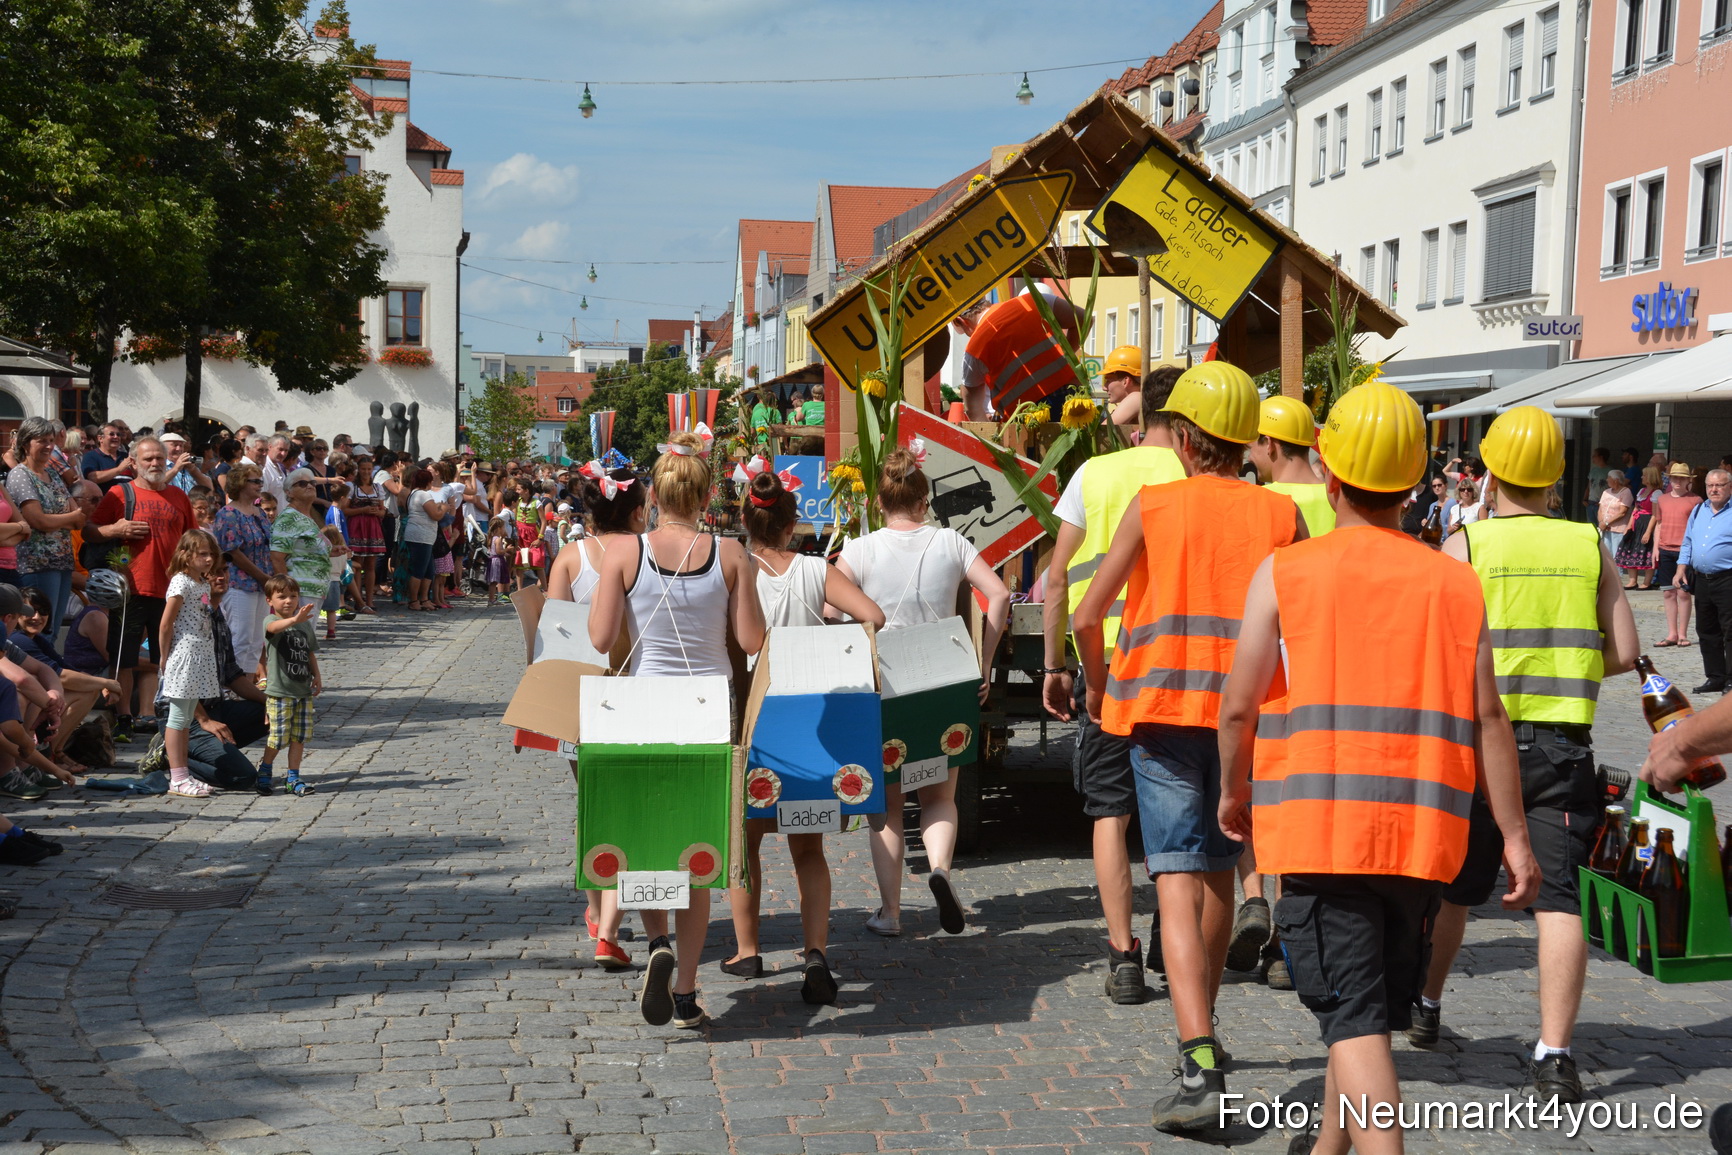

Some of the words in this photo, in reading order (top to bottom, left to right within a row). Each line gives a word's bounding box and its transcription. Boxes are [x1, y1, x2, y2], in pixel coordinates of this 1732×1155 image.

[1161, 168, 1248, 248] Laaber
[1154, 200, 1178, 228] Gde.
[1182, 220, 1224, 262] Pilsach
[1165, 232, 1192, 259] Kreis
[1527, 319, 1581, 336] sutor.
[1489, 566, 1509, 574] DEHN
[1511, 566, 1540, 574] richtigen
[1543, 566, 1557, 574] Weg
[902, 764, 941, 786] Laaber
[779, 806, 836, 827] Laaber
[621, 877, 686, 903] Laaber
